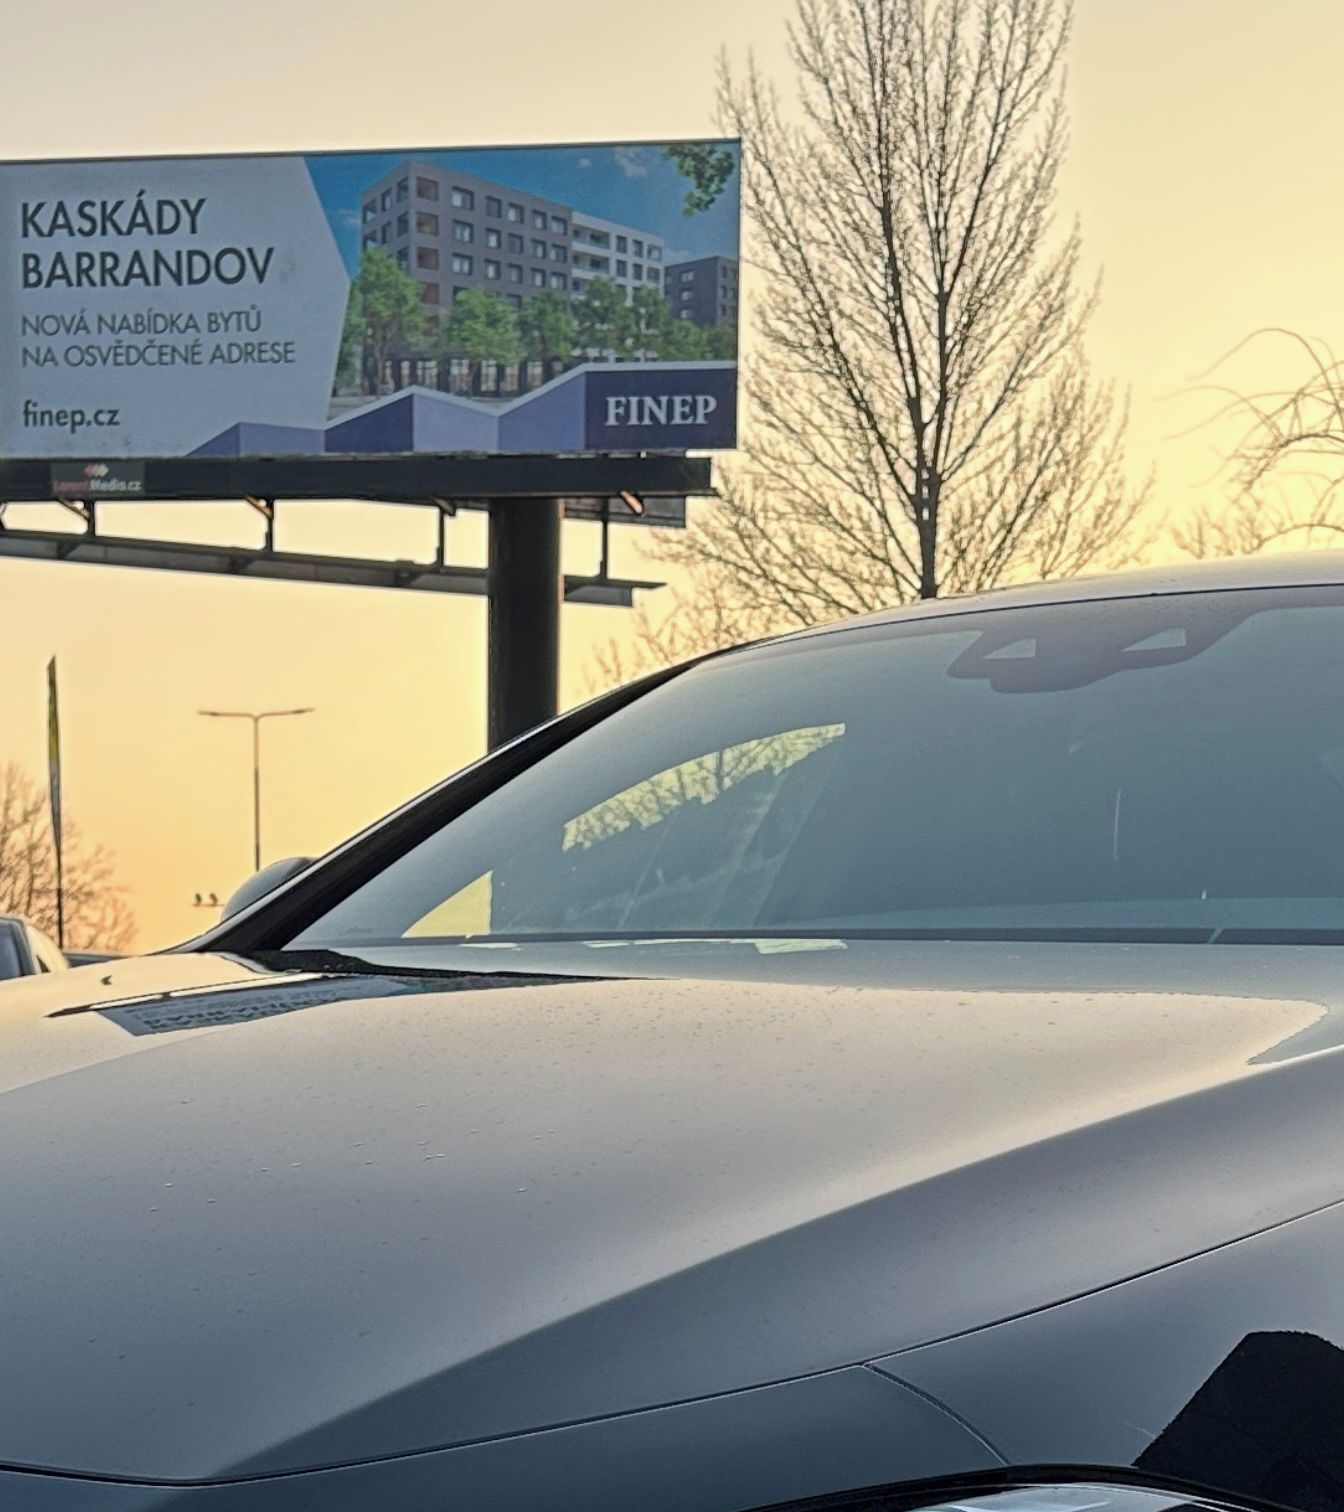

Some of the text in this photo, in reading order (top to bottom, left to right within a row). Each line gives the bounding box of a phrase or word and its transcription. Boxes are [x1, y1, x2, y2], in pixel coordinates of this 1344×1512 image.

[21, 189, 207, 238] KASKÁDY
[22, 247, 274, 289] BARRANDOV
[21, 304, 262, 337] NOVÁ NABÍDKA BYTŮ
[21, 339, 296, 368] NA OSVĚDČENÉ ADRESE
[23, 400, 120, 434] finep.cz
[605, 395, 717, 426] FINEP
